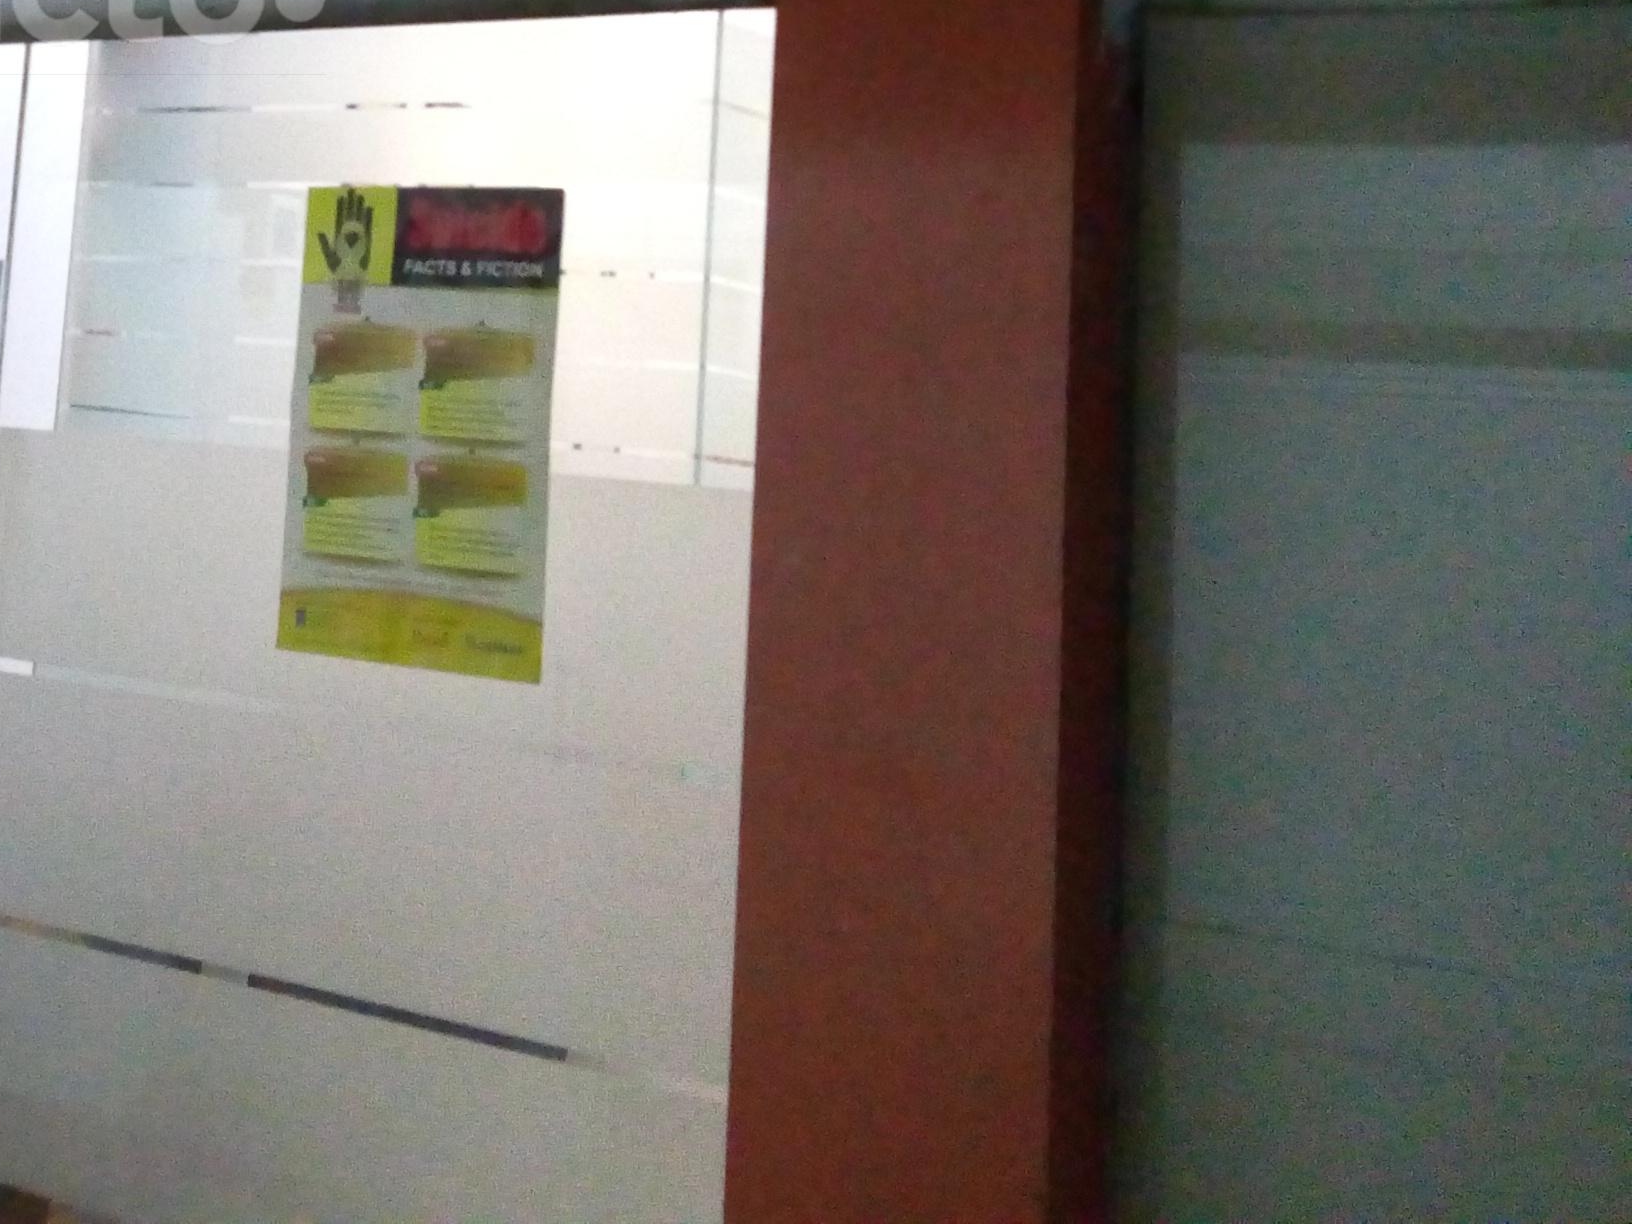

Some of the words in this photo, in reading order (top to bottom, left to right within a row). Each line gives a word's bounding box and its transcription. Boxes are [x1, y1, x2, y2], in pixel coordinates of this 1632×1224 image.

[402, 257, 457, 277] FACTS
[461, 259, 473, 277] &
[477, 259, 545, 278] FICTION
